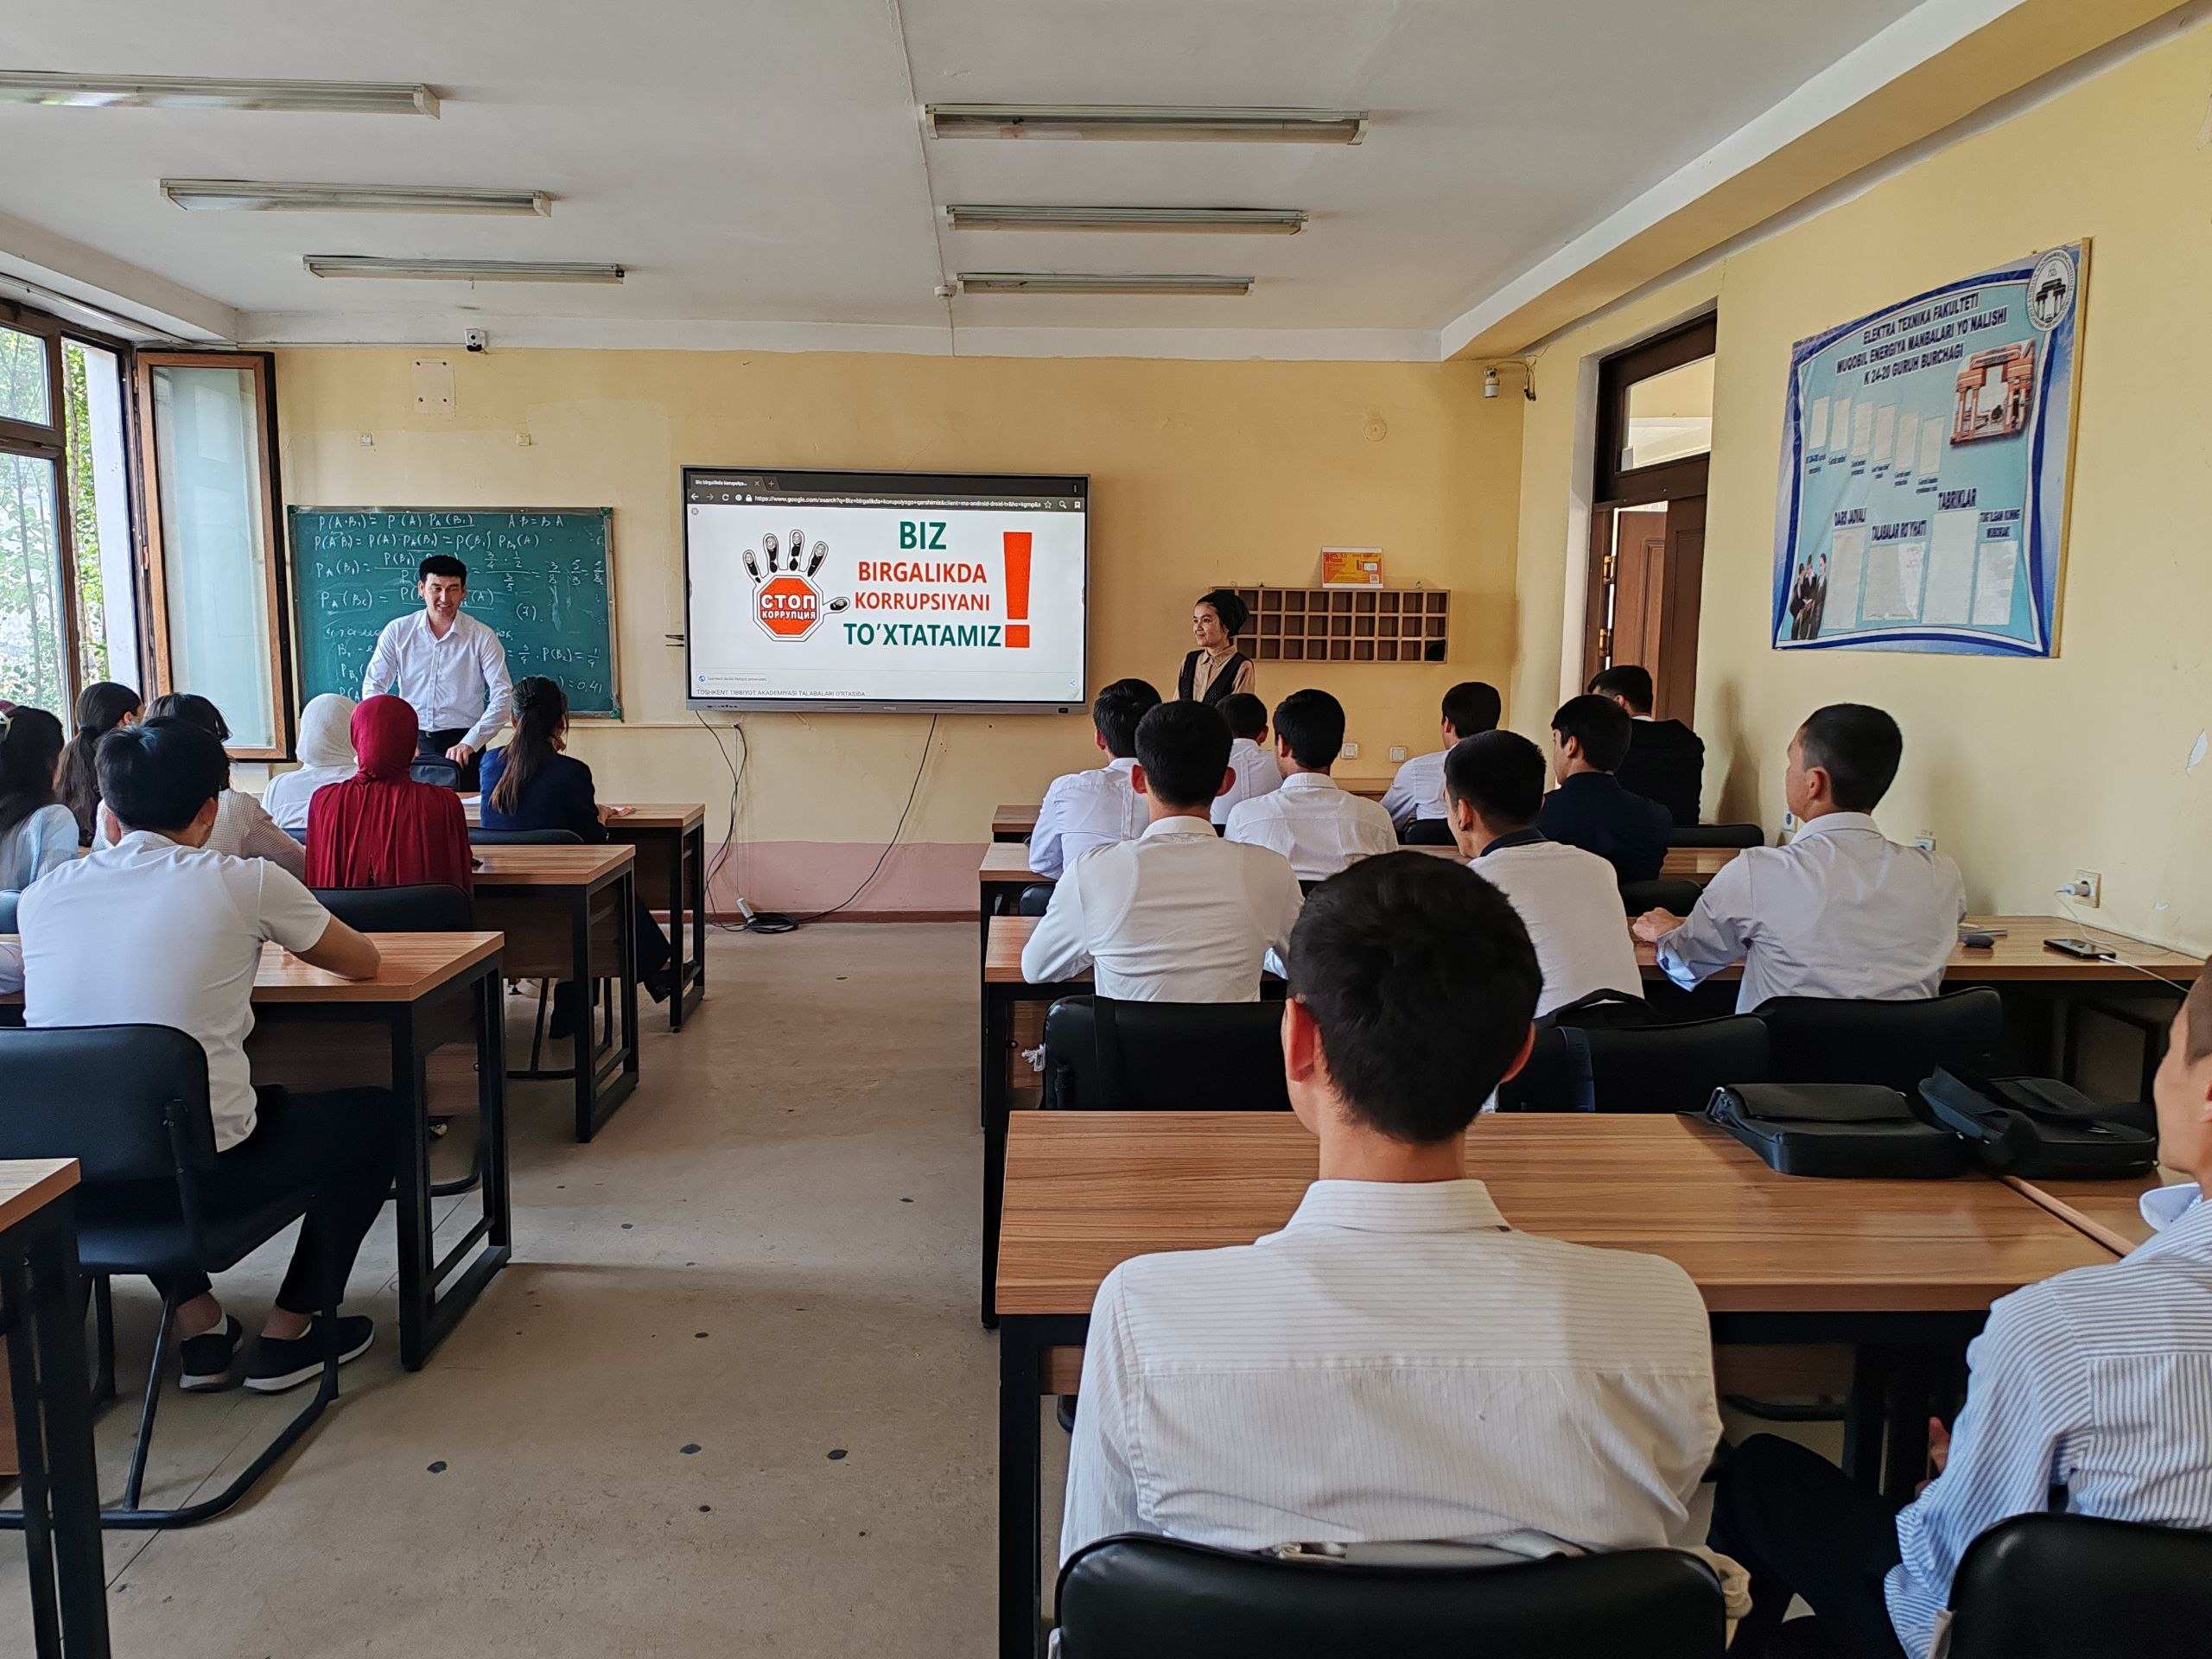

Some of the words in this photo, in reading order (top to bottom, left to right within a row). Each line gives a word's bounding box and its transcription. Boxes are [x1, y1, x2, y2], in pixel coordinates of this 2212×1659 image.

[1863, 322, 1896, 345] ELEKTRA
[1898, 311, 1931, 334] TEXNIKA
[1933, 293, 1979, 320] FAKULTETI
[1837, 354, 1868, 374] MUQOBIL
[1870, 341, 1905, 363] ENERGIYA
[1908, 323, 1954, 350] MANBALARI
[1864, 371, 1870, 385] K
[1892, 356, 1918, 377] GURUH
[1921, 343, 1963, 368] BURCHAGI
[899, 521, 947, 550] BIZ
[858, 562, 987, 583] BIRGALIKDA
[760, 594, 816, 609] СТОП
[855, 592, 990, 611] KORRUPSIYANI
[762, 610, 816, 620] КОРРУПЦИЯ
[843, 622, 1001, 647] TO’XTATAMIZ
